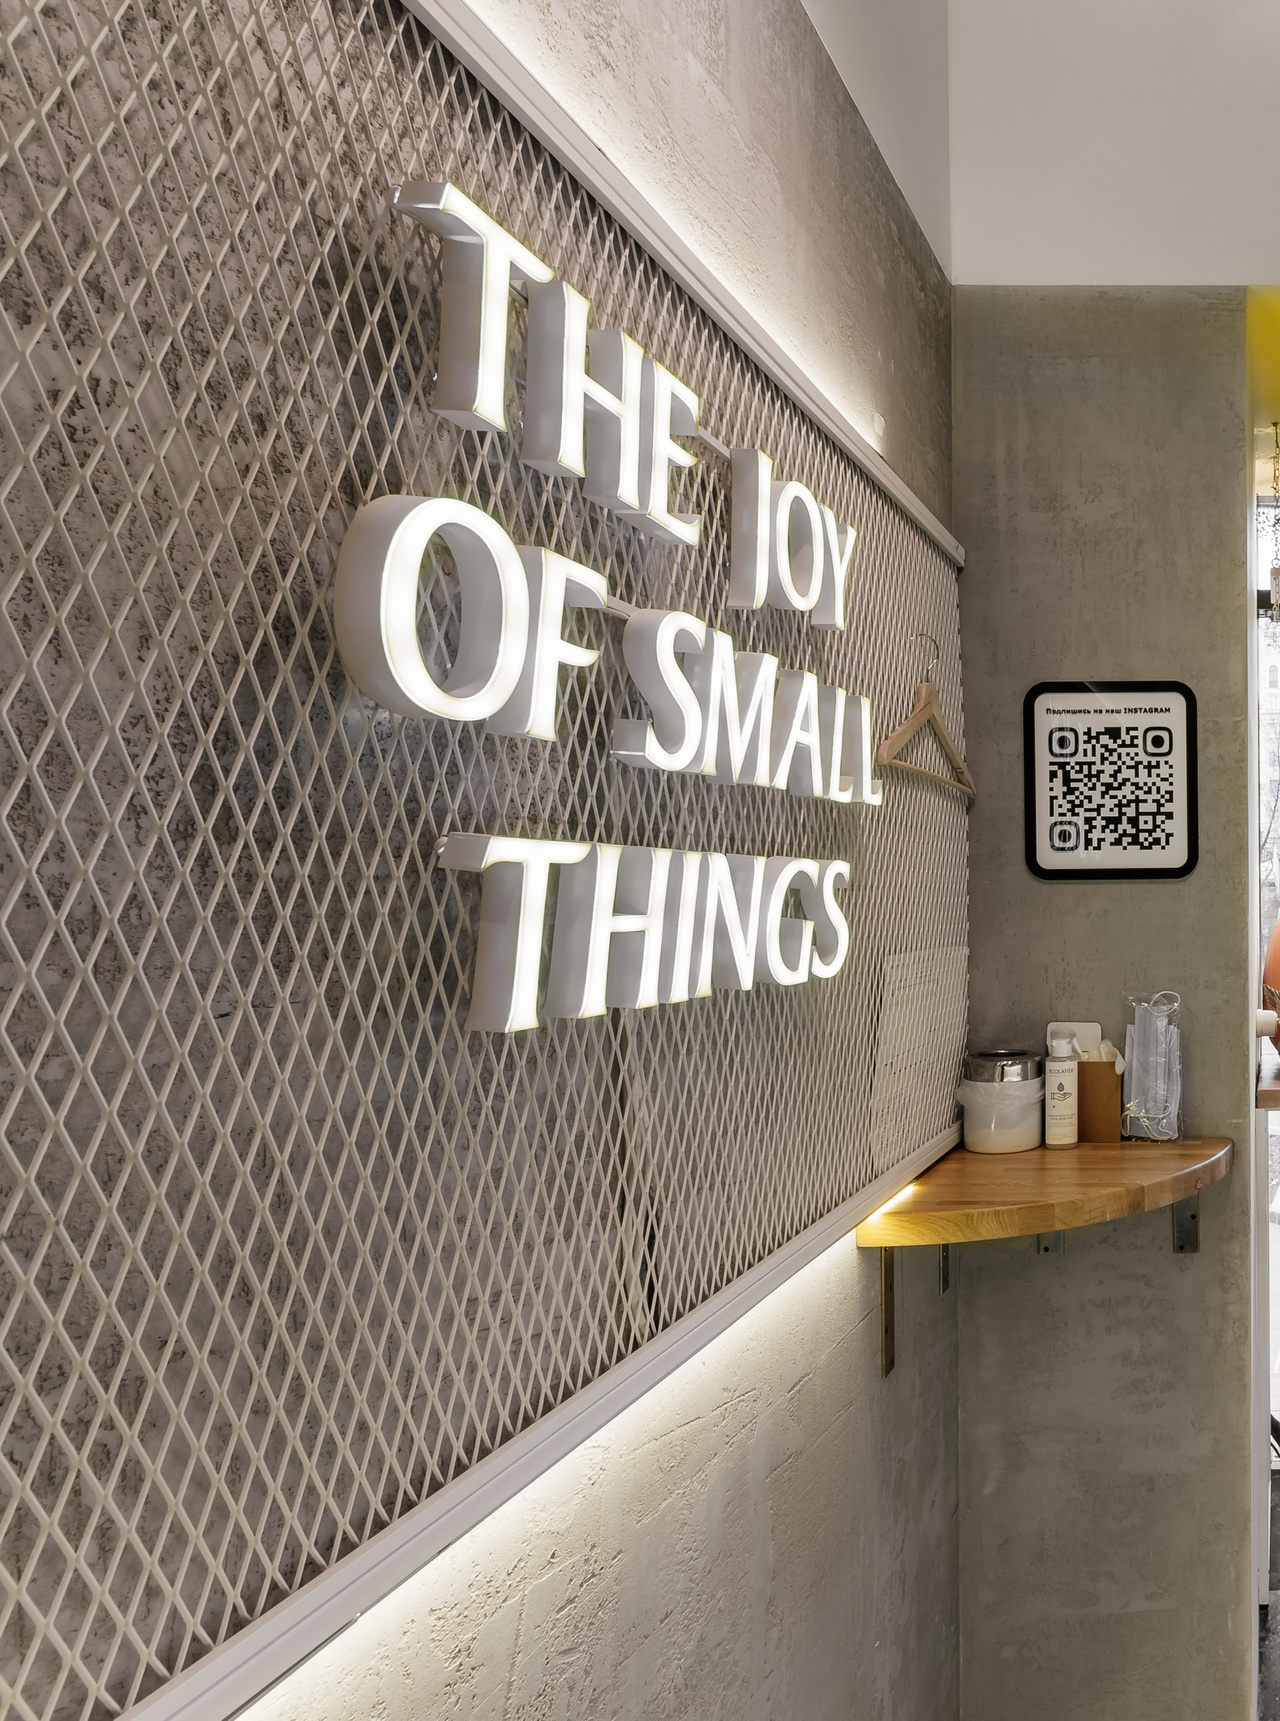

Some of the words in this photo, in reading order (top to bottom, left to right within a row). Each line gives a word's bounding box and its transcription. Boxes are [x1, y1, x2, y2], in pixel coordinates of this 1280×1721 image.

[428, 182, 702, 546] THE
[742, 449, 859, 631] JOY
[365, 497, 608, 742] OF
[630, 611, 884, 806] SMALL
[1046, 708, 1091, 716] Подпишись
[470, 836, 851, 1034] THINGS
